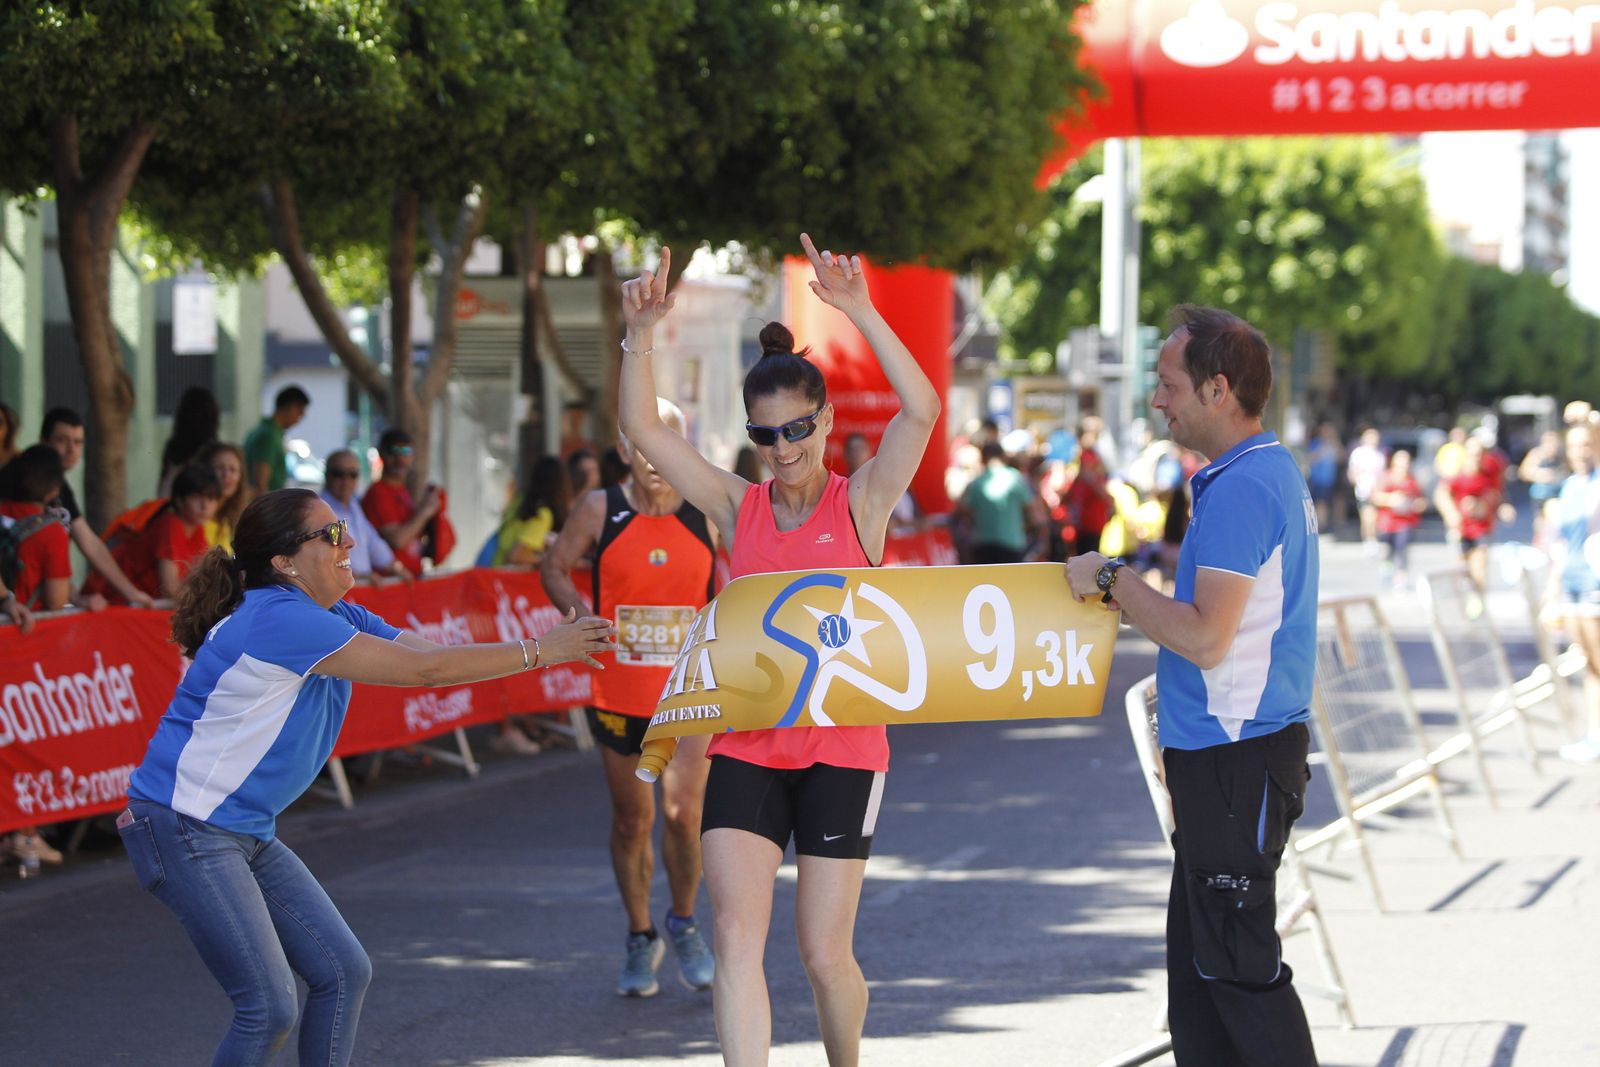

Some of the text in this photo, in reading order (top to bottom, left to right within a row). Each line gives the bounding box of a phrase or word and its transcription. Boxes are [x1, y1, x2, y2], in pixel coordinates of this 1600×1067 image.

[1254, 0, 1600, 64] Santander
[625, 624, 680, 643] 3281
[820, 616, 851, 647] 300
